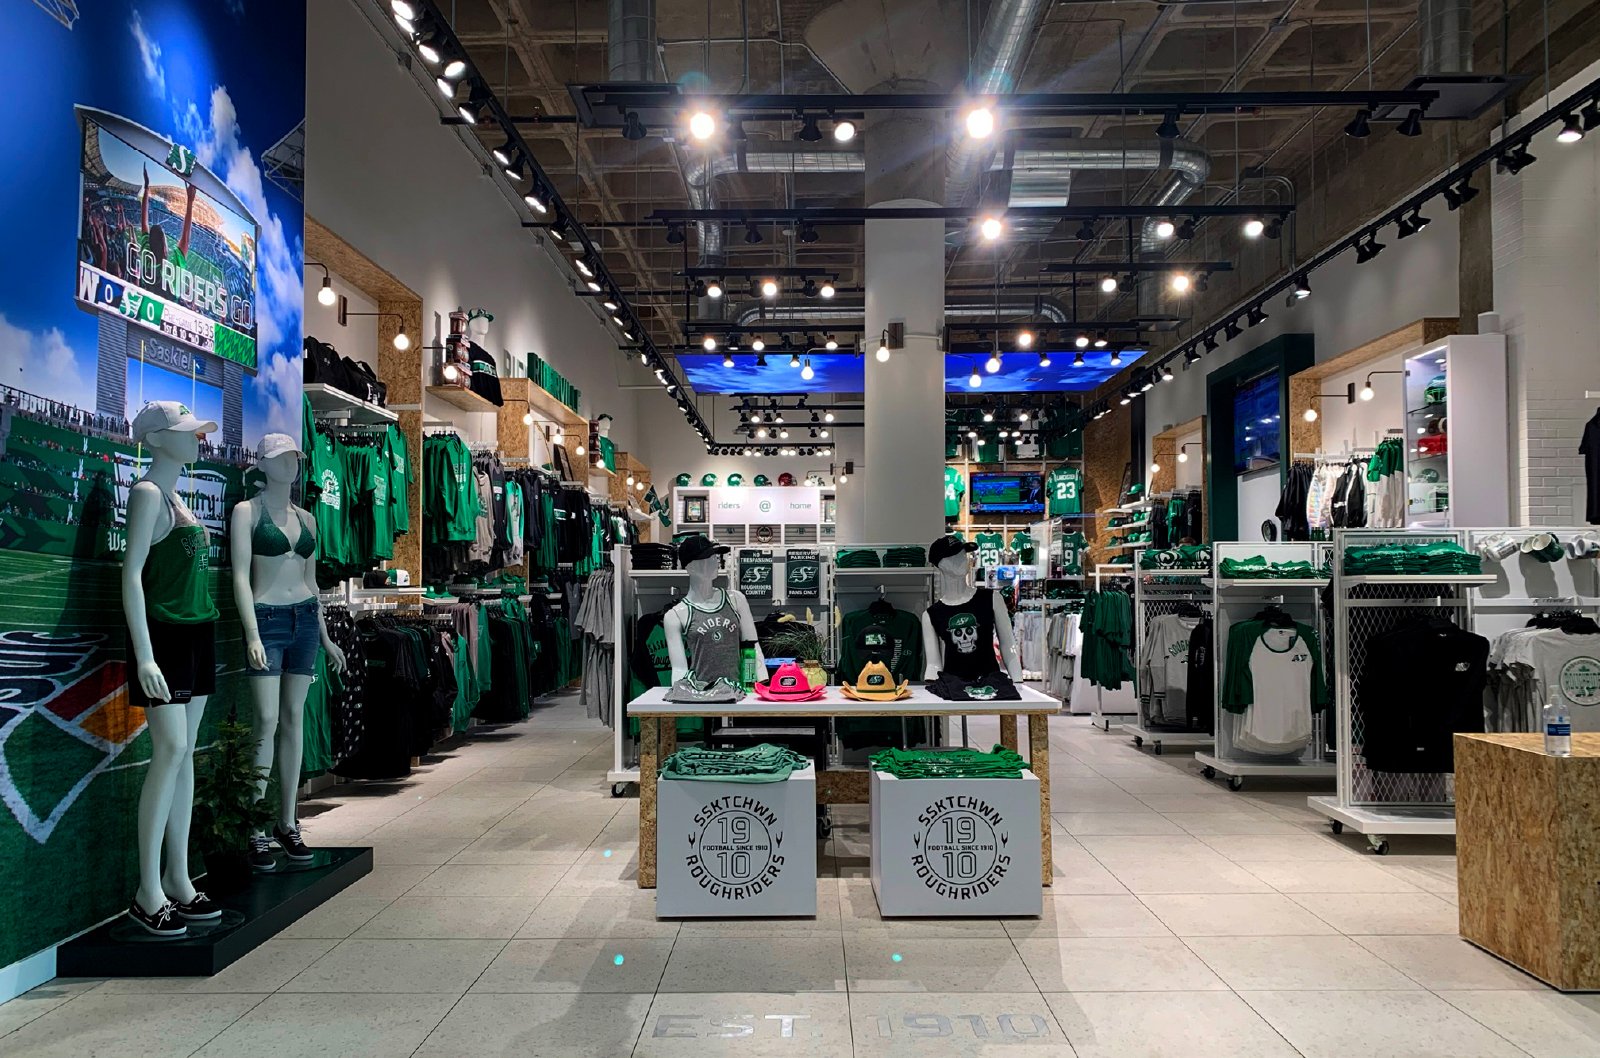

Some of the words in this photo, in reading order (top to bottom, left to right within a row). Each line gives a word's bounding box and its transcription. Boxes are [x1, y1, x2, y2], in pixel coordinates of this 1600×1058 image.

[126, 241, 156, 285] GO
[162, 258, 228, 318] RIDERS
[231, 294, 253, 330] GO
[146, 302, 155, 322] 0
[149, 338, 192, 370] SaskTel
[1057, 482, 1075, 499] 23
[759, 500, 771, 512] @
[107, 531, 127, 552] We
[981, 549, 999, 567] 29
[696, 616, 737, 636] RIDERS
[693, 795, 777, 827] SSKTCHWN
[918, 795, 1003, 827] SSKTCHWN
[717, 816, 750, 844] 19
[942, 816, 975, 844] 19
[686, 854, 785, 900] ROUGHRIDERS
[717, 851, 750, 878] 10
[911, 854, 1011, 900] ROUGHRIDERS
[942, 851, 976, 878] 10
[865, 1014, 1051, 1038] 1910
